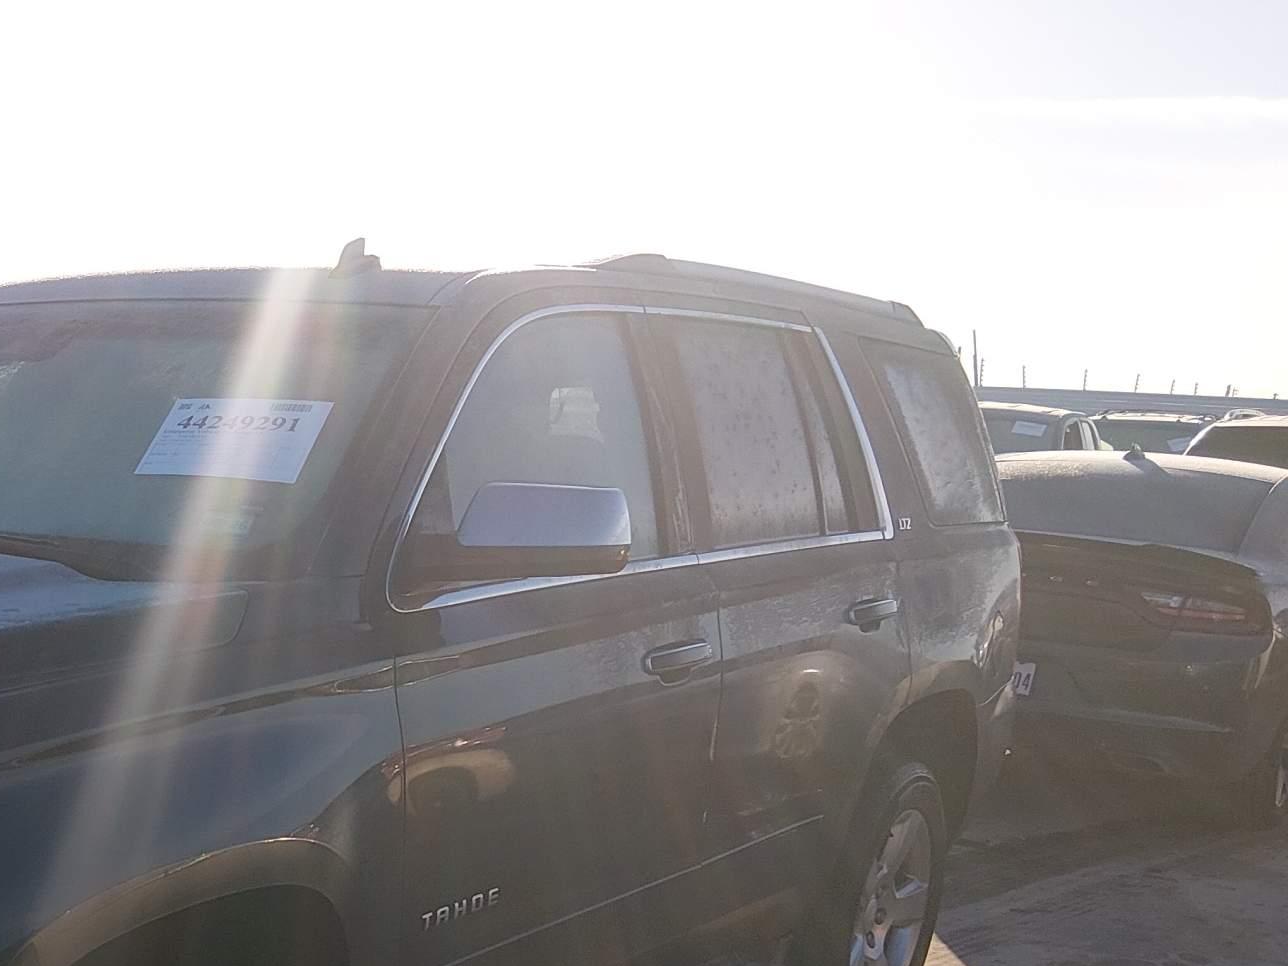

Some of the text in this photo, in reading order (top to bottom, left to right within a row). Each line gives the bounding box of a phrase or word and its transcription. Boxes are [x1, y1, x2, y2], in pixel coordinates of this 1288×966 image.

[177, 415, 300, 432] 44249291
[898, 517, 912, 530] LTZ
[421, 887, 499, 931] TAHOE
